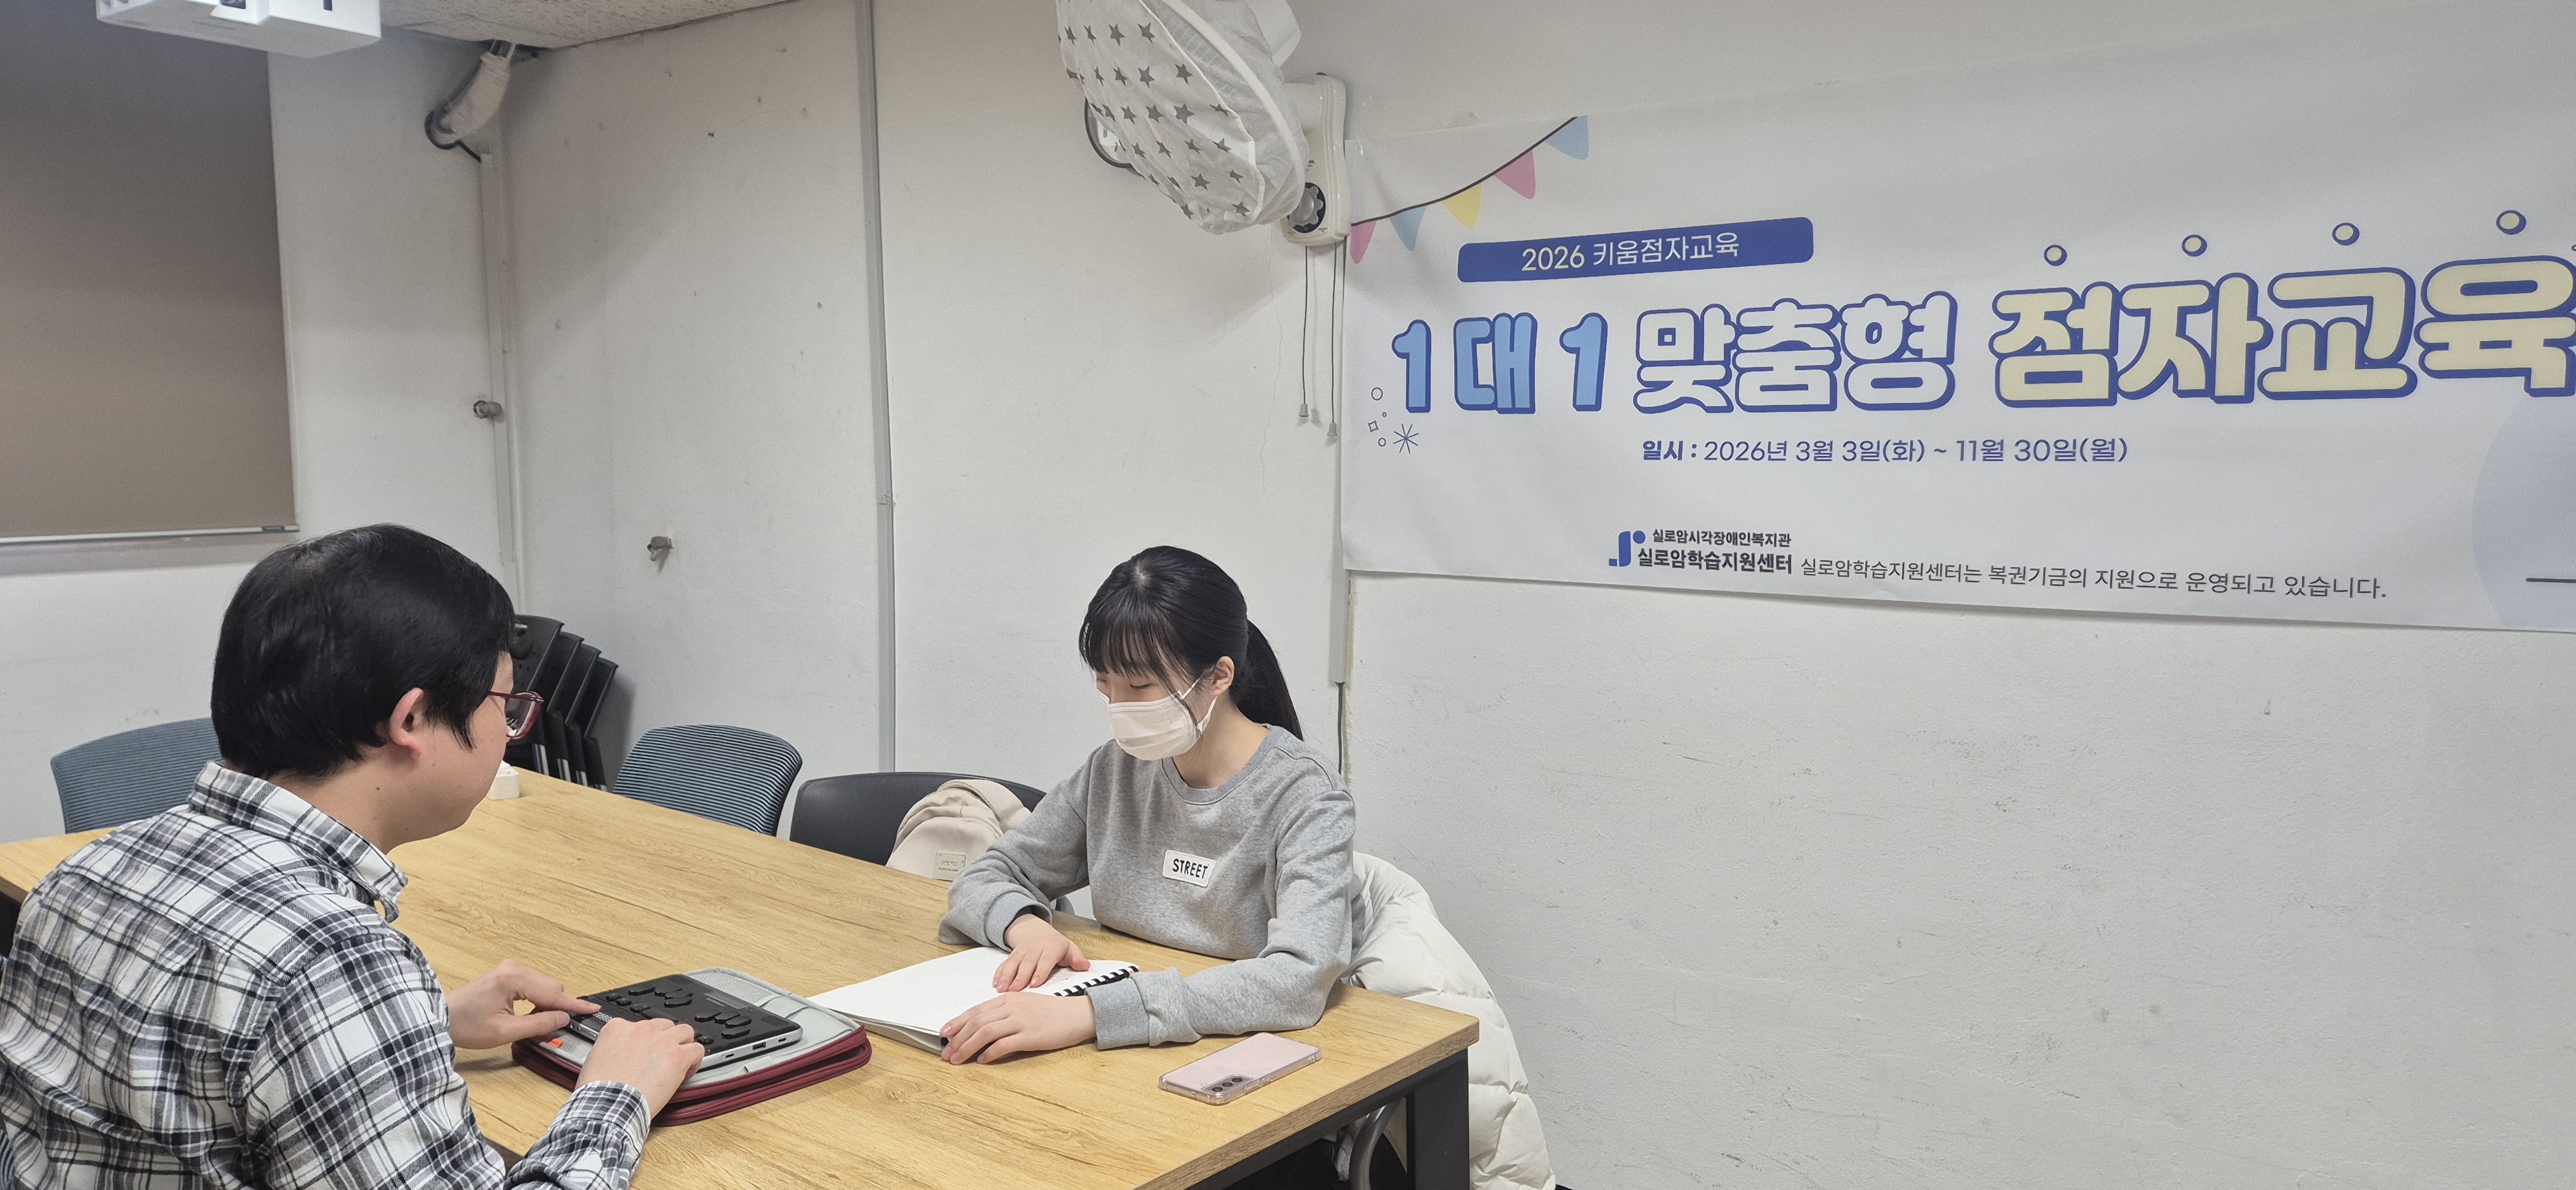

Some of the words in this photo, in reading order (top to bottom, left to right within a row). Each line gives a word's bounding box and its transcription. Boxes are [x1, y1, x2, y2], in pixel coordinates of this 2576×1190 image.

[1521, 245, 1584, 271] 2026
[1593, 232, 1739, 266] 키움점자교육
[1392, 319, 1431, 413] 1
[1454, 312, 1538, 414] 대
[1559, 312, 1608, 411] 1
[1633, 291, 1958, 413] 맞춤형
[1989, 255, 2576, 408] 점자교육
[1642, 440, 1683, 461] 일시
[1704, 440, 1788, 462] 2026년
[1795, 440, 1833, 462] 3월
[1842, 439, 1926, 462] 3일(화)
[1956, 439, 2004, 462] 11월
[2014, 438, 2127, 462] 30일(월)
[1653, 529, 1792, 547] 실로암시각장애인복지관
[1637, 547, 1792, 574] 실로암학습지원센터
[1801, 558, 1982, 583] 실로암학습지원센터는
[1988, 565, 2087, 587] 복권기금의
[2094, 569, 2178, 590] 지원으로
[2185, 572, 2276, 594] 운영되고
[2284, 575, 2387, 600] 있습니다.
[1172, 858, 1208, 878] STREET
